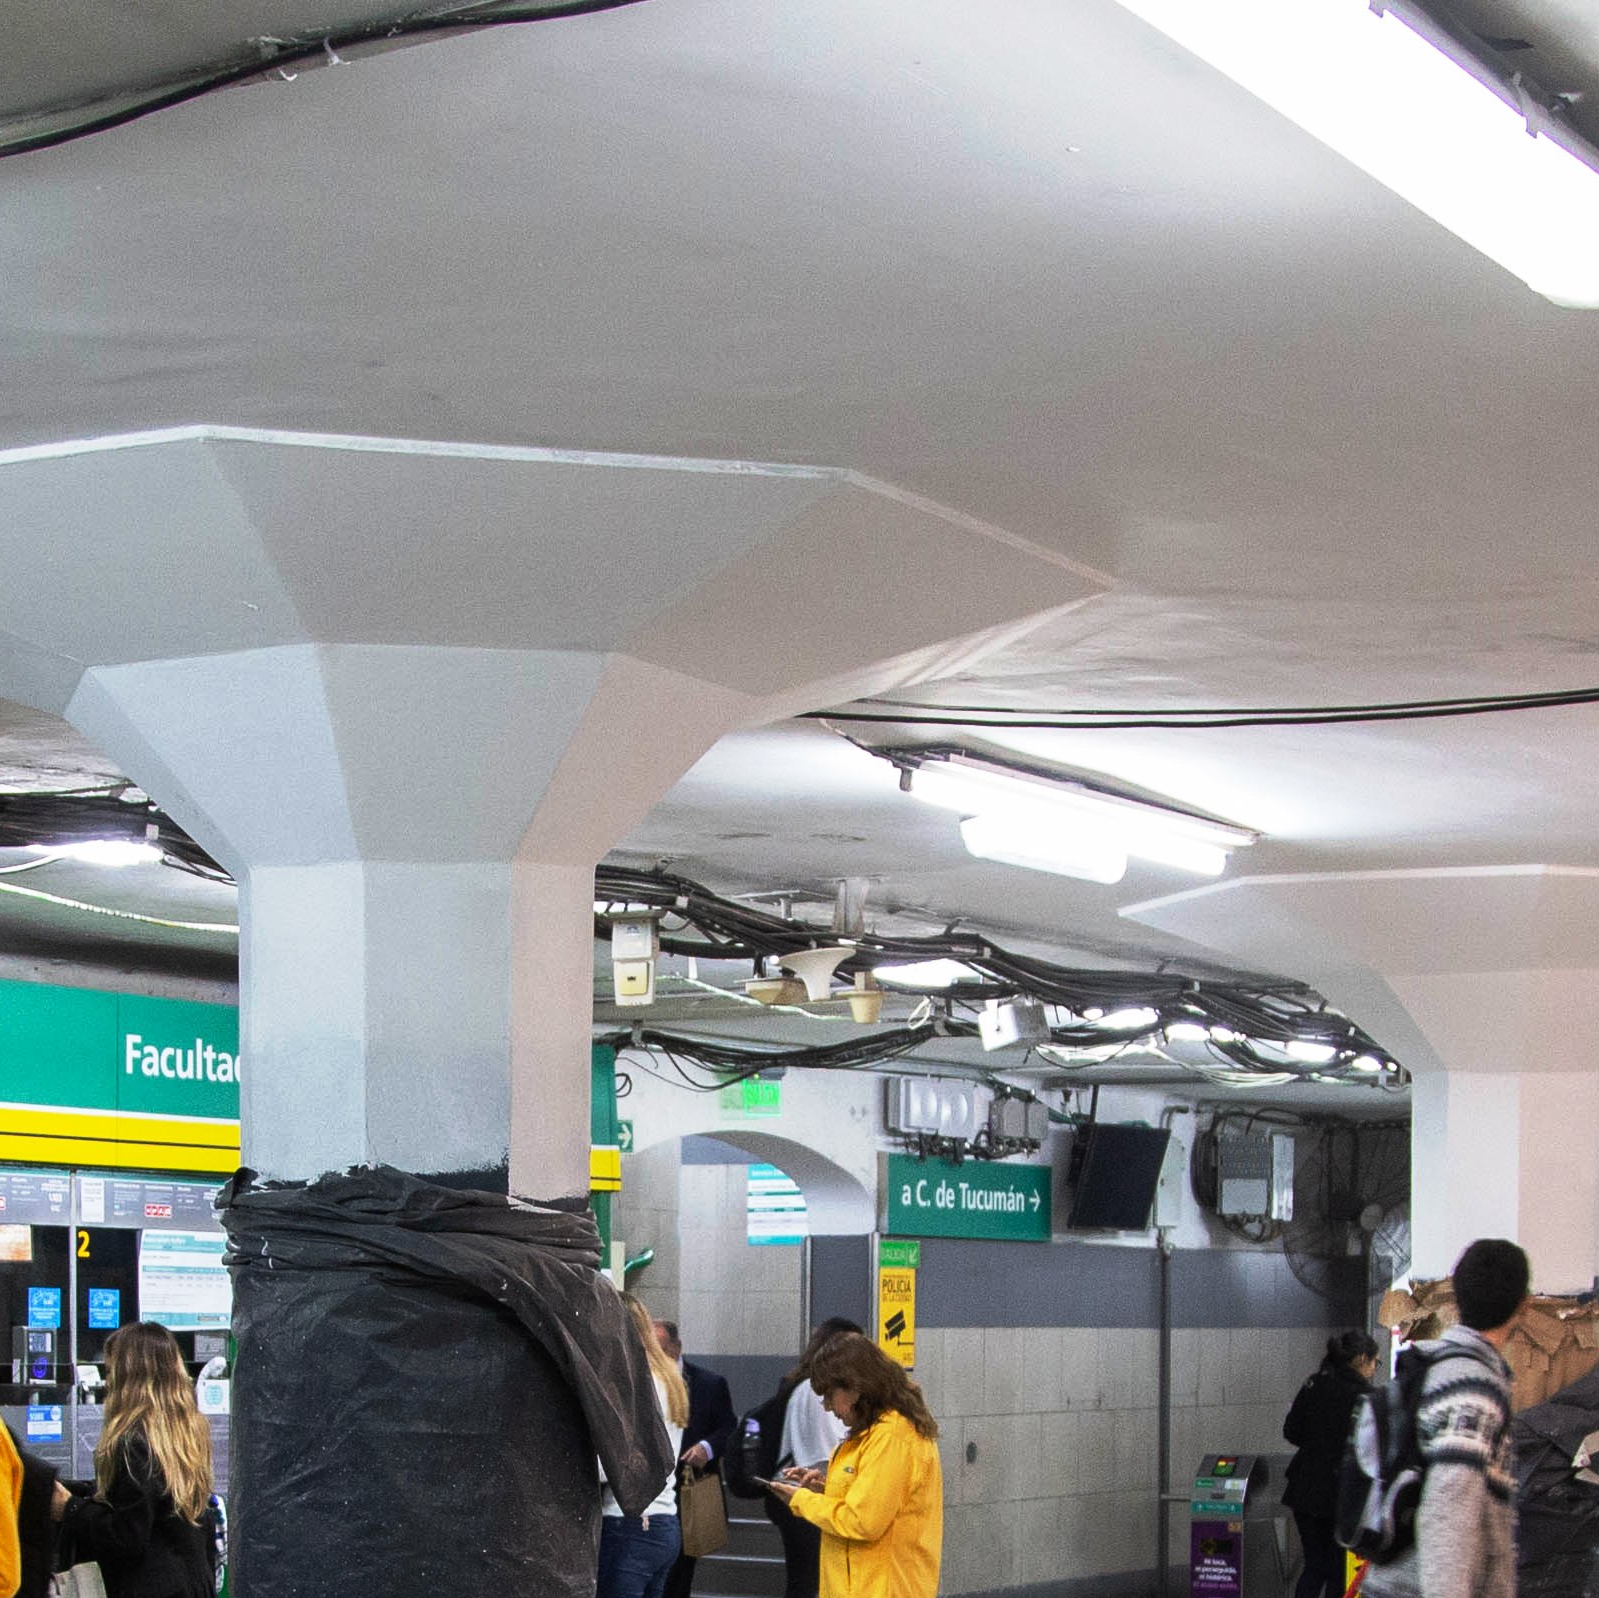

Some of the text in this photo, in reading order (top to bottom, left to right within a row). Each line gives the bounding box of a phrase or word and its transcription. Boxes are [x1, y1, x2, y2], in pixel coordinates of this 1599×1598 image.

[901, 1179, 1025, 1213] a C. de Tucumán
[77, 1230, 90, 1258] 2
